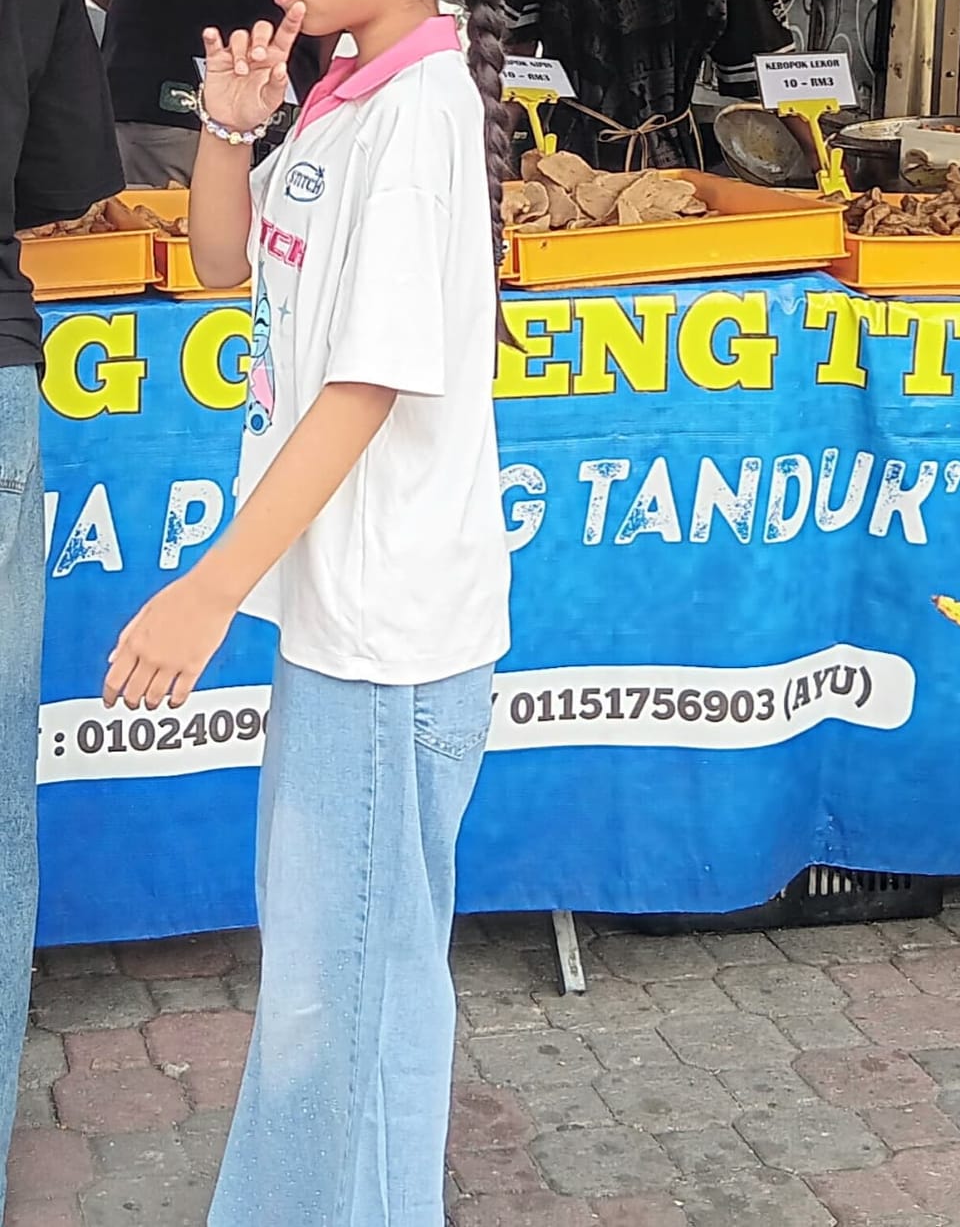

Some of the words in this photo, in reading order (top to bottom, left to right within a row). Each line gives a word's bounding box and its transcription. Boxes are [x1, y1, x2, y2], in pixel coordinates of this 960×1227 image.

[810, 59, 840, 69] LEKOR
[783, 78, 798, 88] 10
[810, 76, 834, 88] RM3
[510, 687, 776, 725] 01151756903
[782, 665, 873, 720] (AYU)
